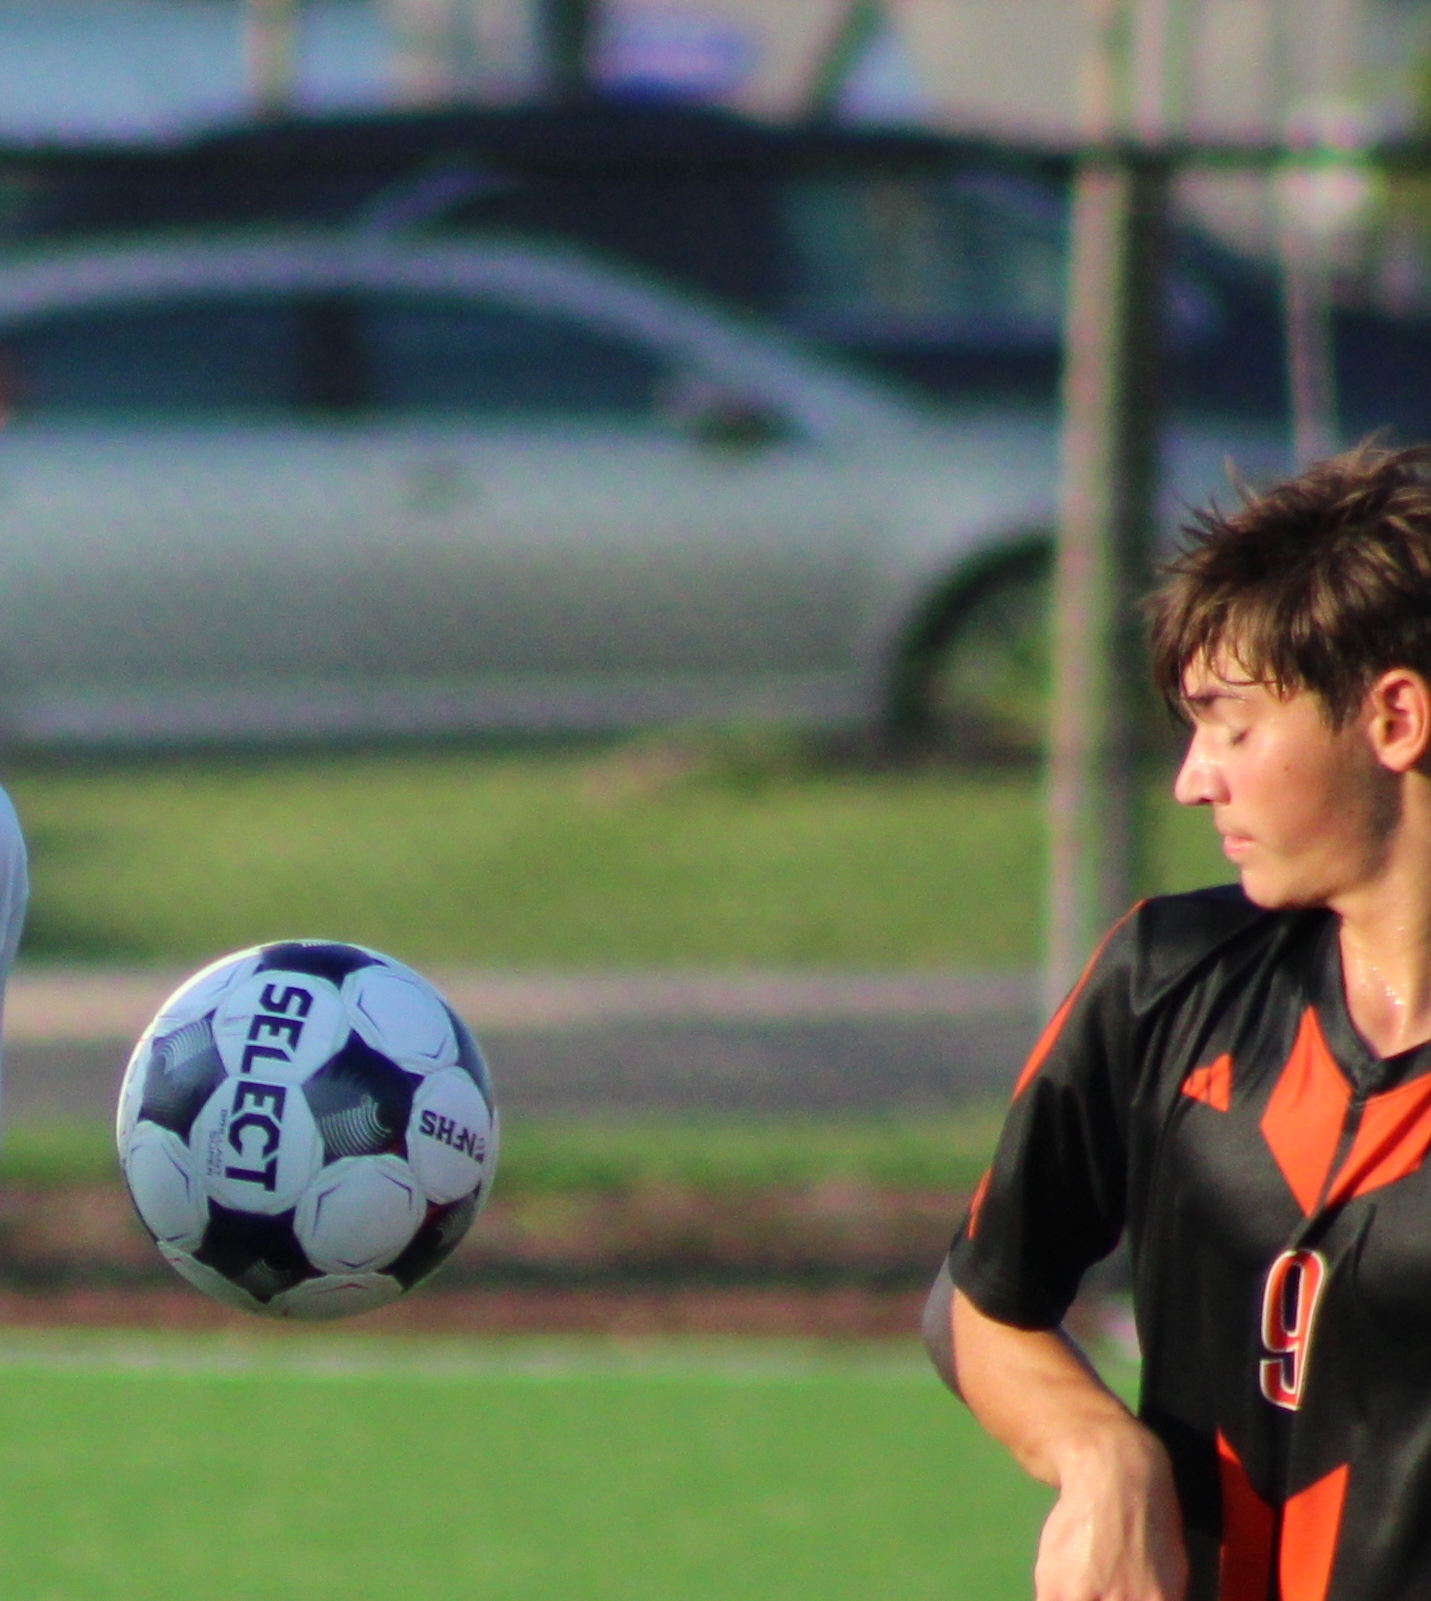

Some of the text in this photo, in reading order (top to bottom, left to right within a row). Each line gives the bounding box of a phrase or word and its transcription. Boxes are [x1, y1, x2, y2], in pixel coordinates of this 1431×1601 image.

[224, 983, 314, 1192] SELECT
[418, 1109, 477, 1160] NFHS
[1260, 1250, 1324, 1411] 9
